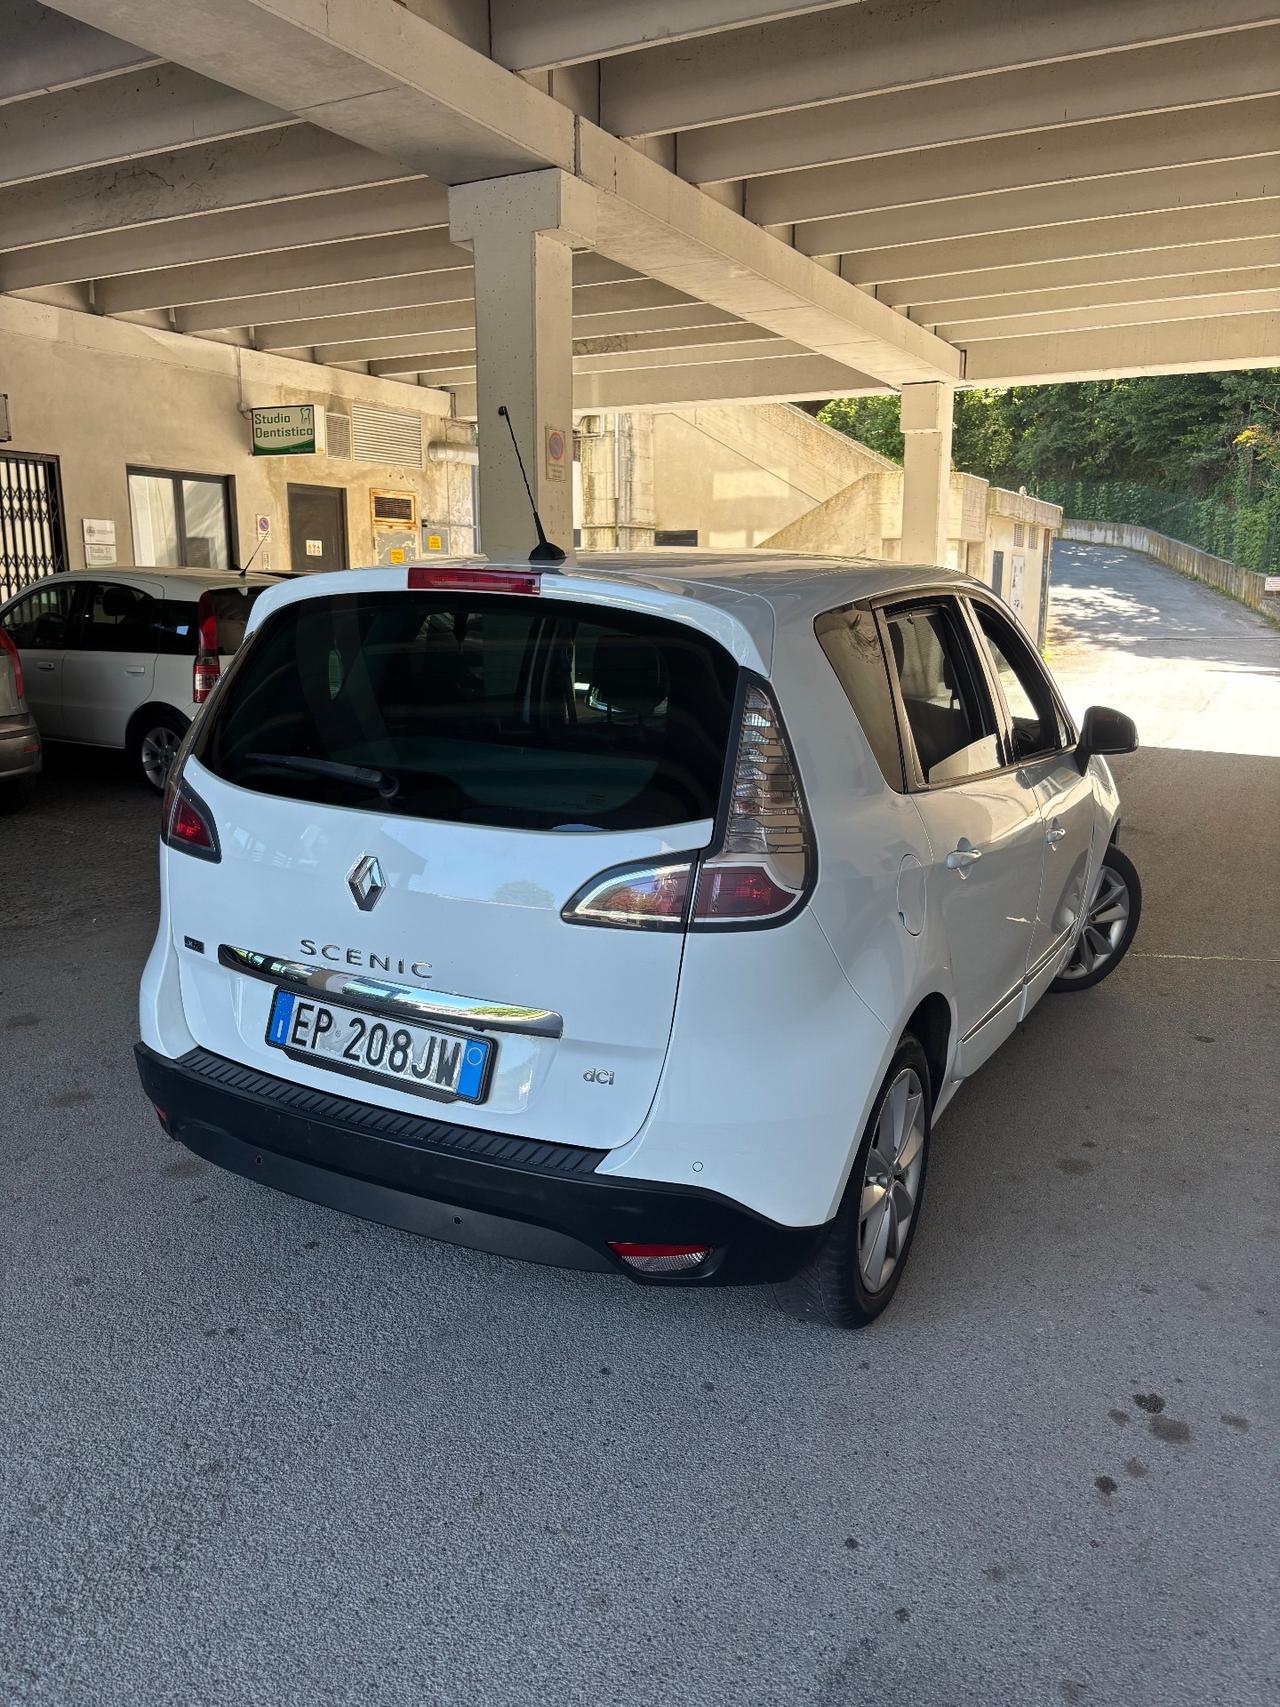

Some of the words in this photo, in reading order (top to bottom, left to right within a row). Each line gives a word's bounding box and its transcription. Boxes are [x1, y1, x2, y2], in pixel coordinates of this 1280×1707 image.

[255, 412, 291, 424] Studio
[255, 427, 313, 438] Dentistico
[300, 939, 433, 979] SCENIC
